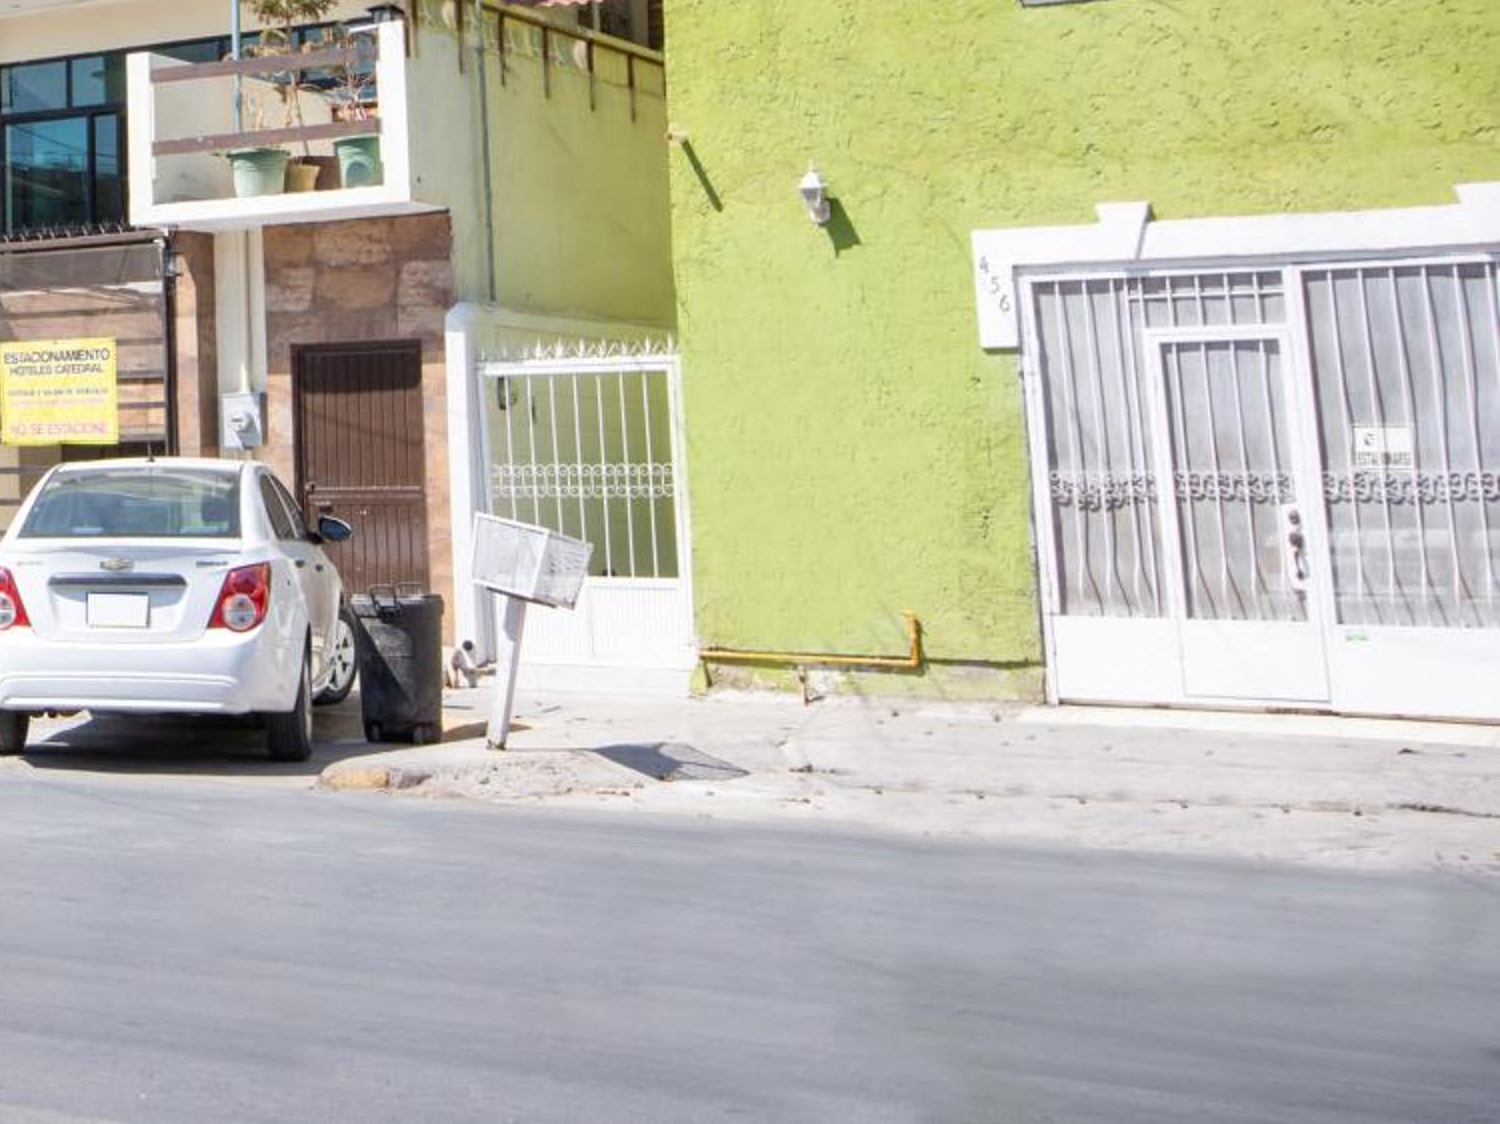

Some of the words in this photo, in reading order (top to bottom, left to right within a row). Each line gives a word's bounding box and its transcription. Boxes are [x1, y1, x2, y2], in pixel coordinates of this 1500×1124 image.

[4, 348, 109, 364] ESTACIONAMIENTO
[10, 365, 52, 375] HOTELES
[55, 363, 103, 374] CATEDRAL
